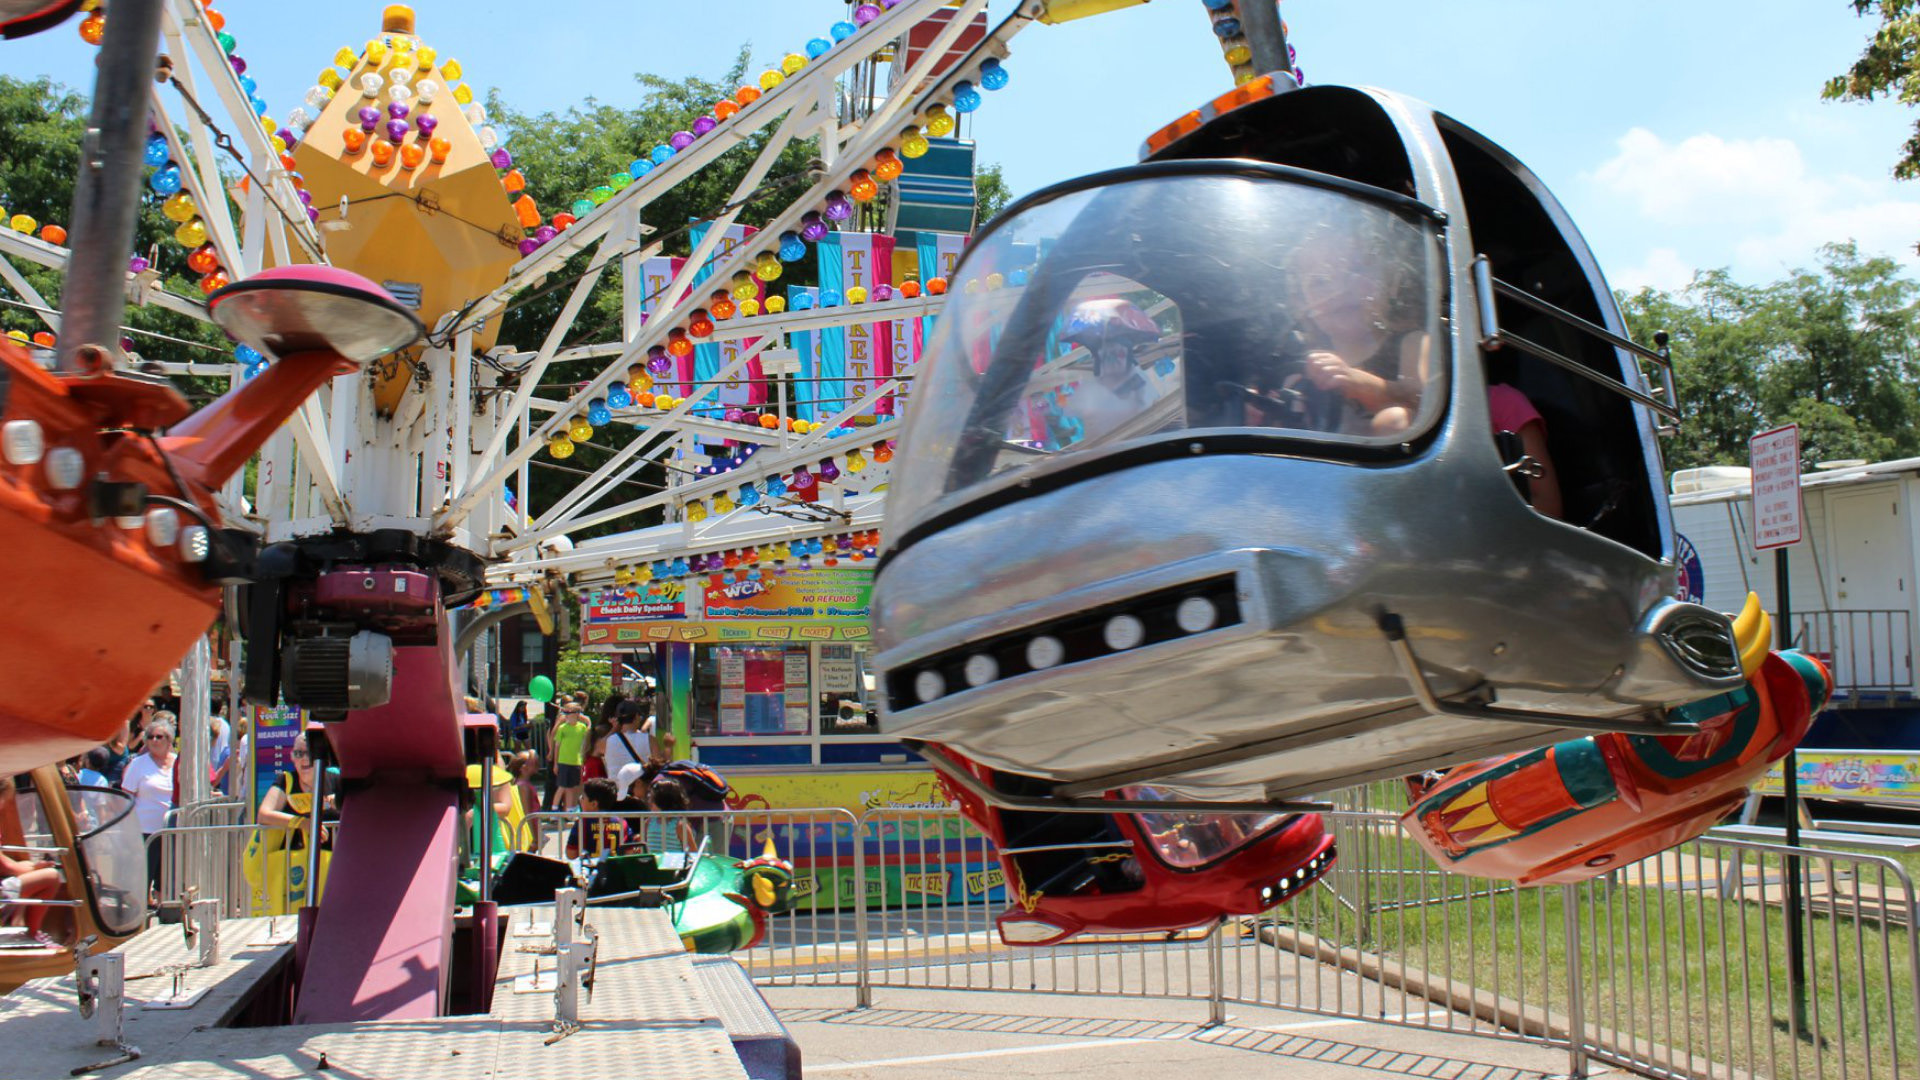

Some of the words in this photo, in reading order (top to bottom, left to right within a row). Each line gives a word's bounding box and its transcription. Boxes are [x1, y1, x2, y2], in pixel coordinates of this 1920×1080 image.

[723, 582, 765, 599] WCA
[802, 595, 815, 603] NO
[817, 595, 857, 603] REFUNDS
[600, 606, 622, 614] Check
[623, 605, 642, 614] Daily
[643, 604, 674, 614] Specials
[762, 628, 787, 637] TICKETS
[804, 628, 829, 637] TICKETS
[257, 730, 289, 739] MEASURE
[289, 729, 299, 738] UP
[1827, 769, 1870, 784] WCA
